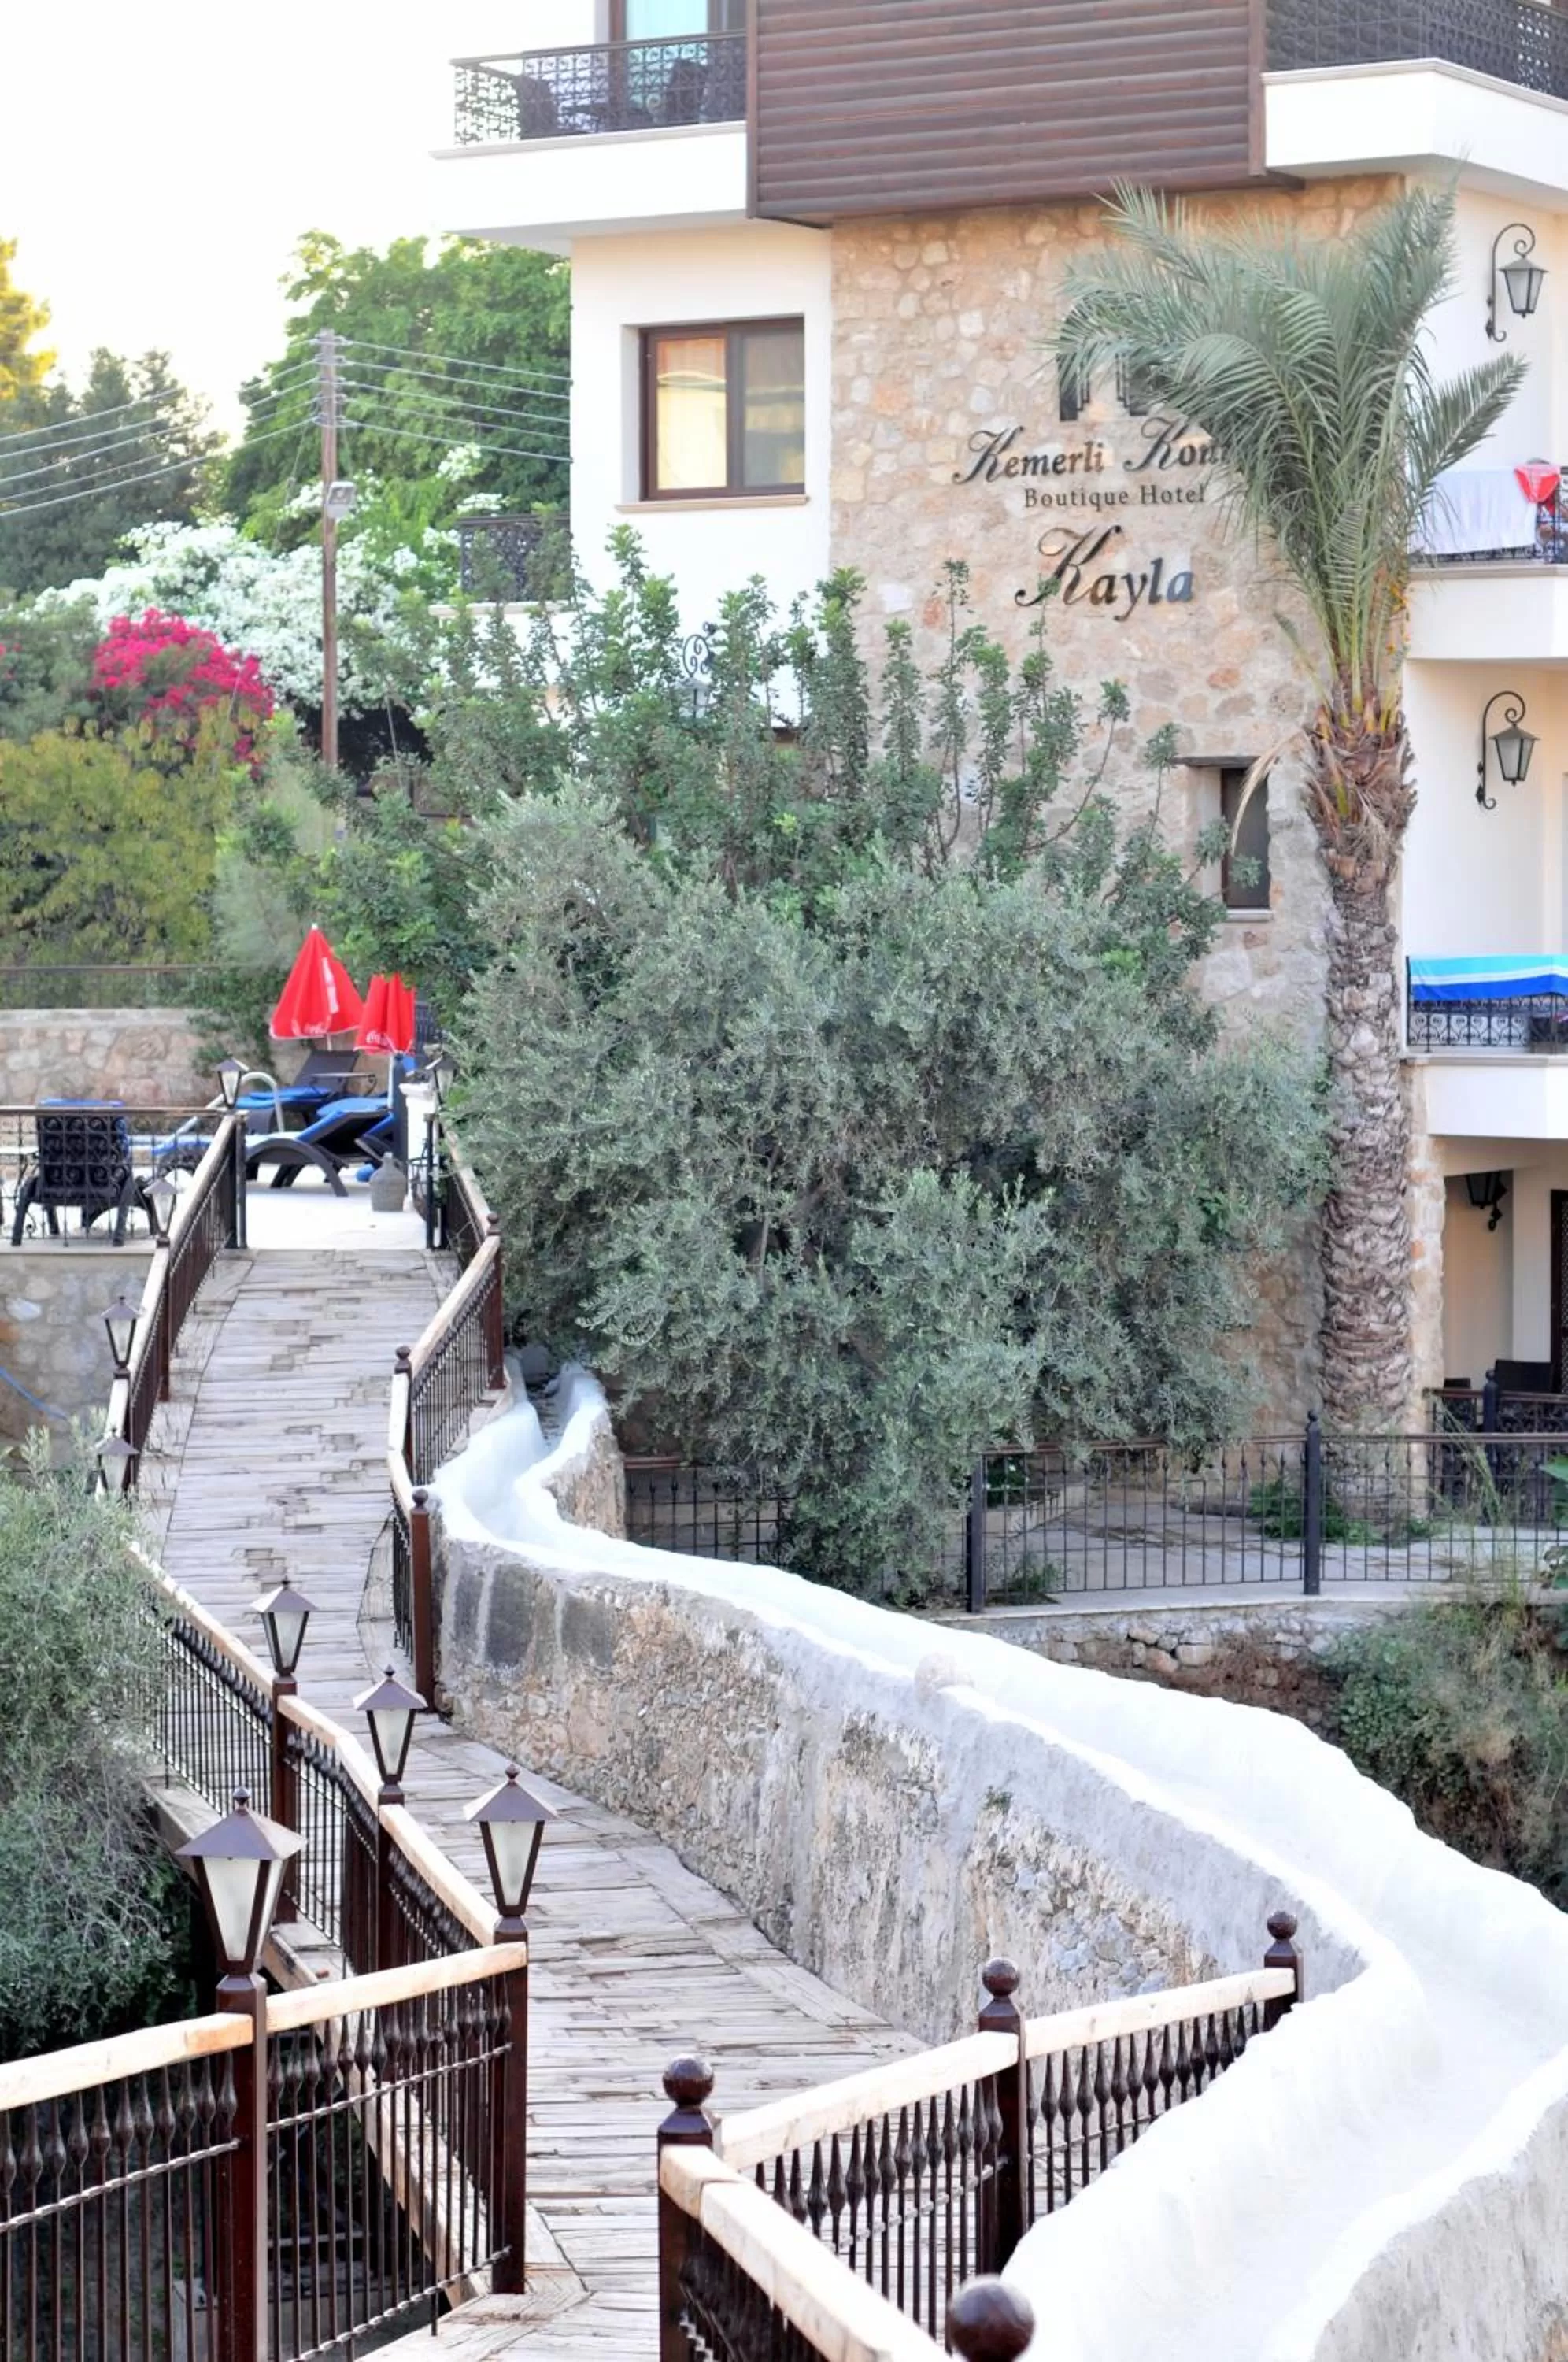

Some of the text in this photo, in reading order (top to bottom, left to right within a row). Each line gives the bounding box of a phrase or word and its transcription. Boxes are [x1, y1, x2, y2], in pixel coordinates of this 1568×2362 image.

[952, 416, 1231, 485] Kemerli Kon
[1024, 483, 1205, 513] Boutique Hotel
[1014, 524, 1195, 622] Kayla
